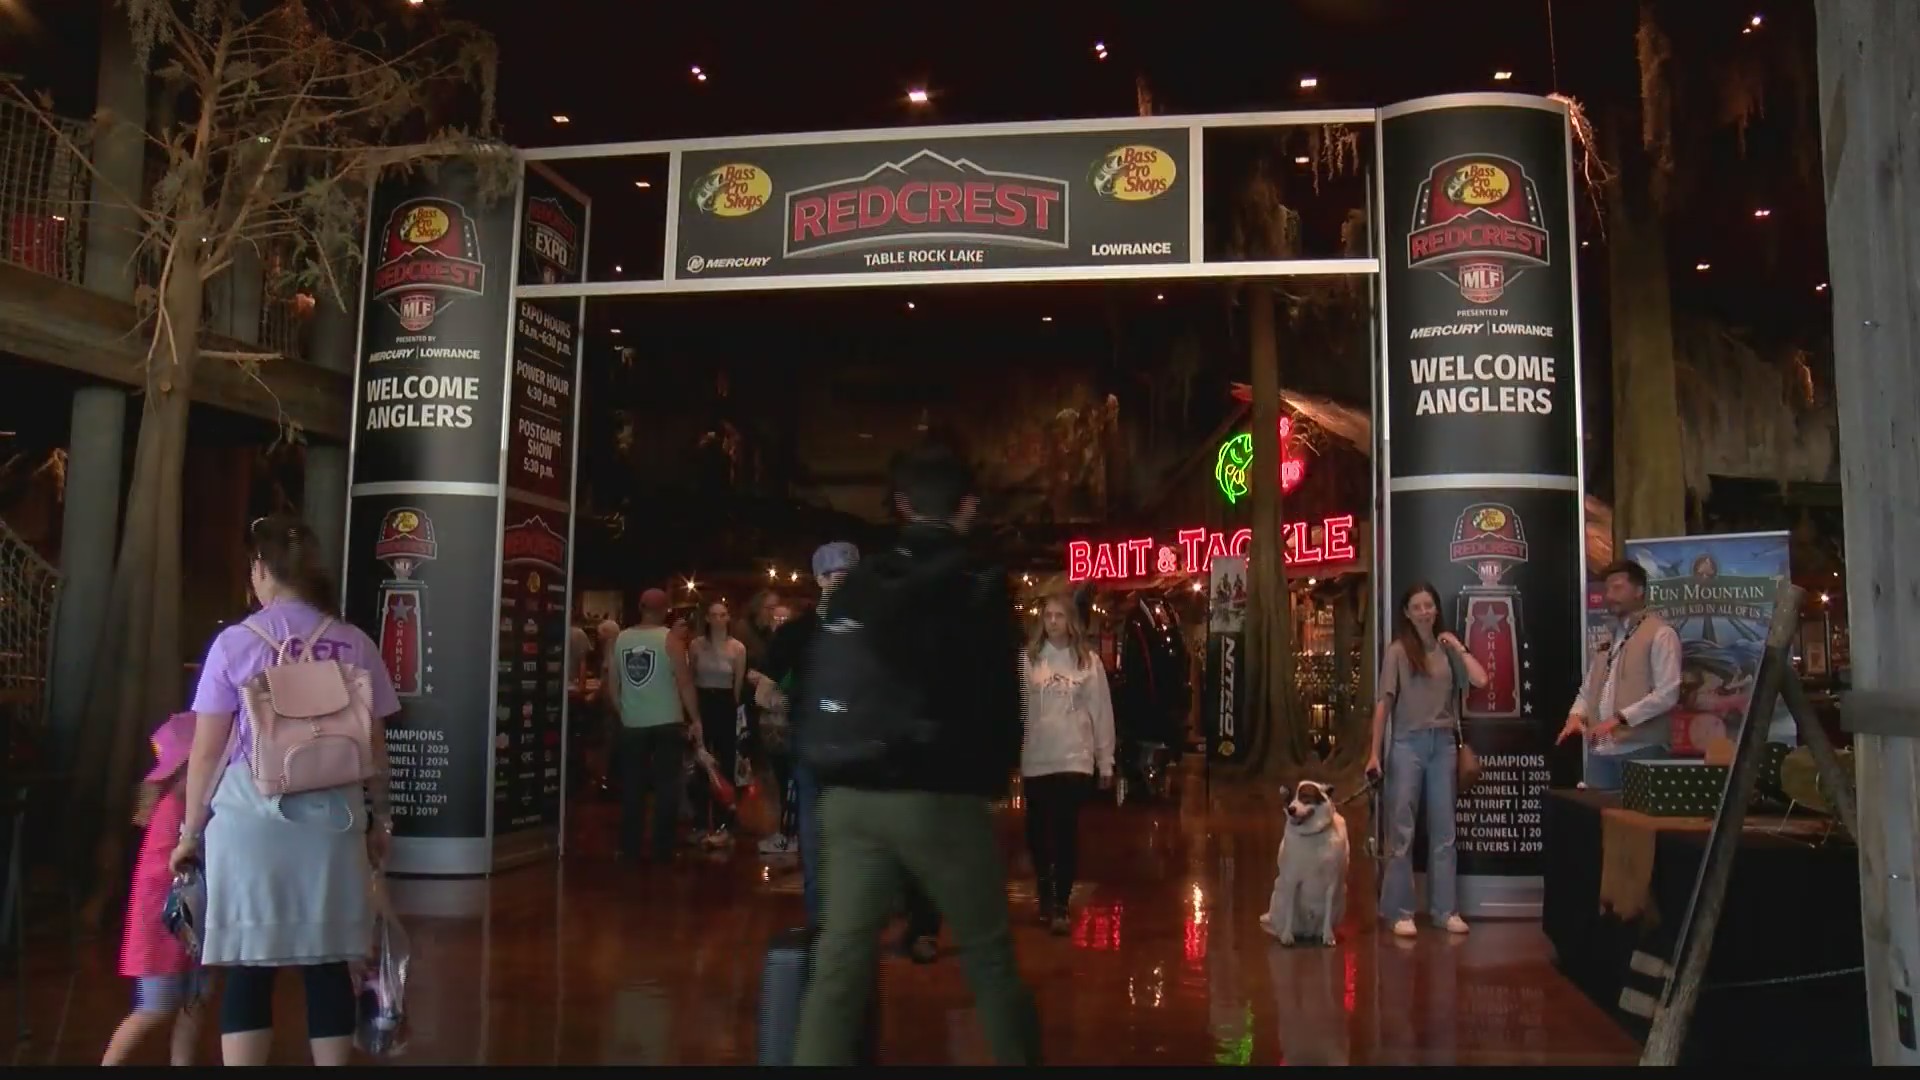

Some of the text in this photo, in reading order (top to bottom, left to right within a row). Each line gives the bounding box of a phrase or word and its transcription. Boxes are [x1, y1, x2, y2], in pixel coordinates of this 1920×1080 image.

[1124, 148, 1157, 163] Bass
[725, 166, 755, 180] Bass
[1125, 163, 1150, 178] Pro
[1470, 165, 1495, 177] Bass
[725, 181, 748, 195] Pro
[1124, 177, 1167, 194] Shops
[1472, 177, 1490, 188] Pro
[1472, 187, 1502, 200] Shops
[724, 193, 763, 210] Shops
[417, 208, 437, 218] Bass
[793, 181, 1059, 241] REDCREST
[536, 231, 567, 266] EXPO
[1091, 243, 1172, 256] LOWRANCE
[1412, 226, 1545, 258] REDCREST
[706, 257, 771, 268] MERCURY
[864, 249, 985, 266] TABLE ROCK LAKE
[376, 261, 480, 289] REDCREST
[1463, 270, 1500, 289] MLF
[403, 301, 431, 318] MLF
[1456, 308, 1509, 317] PRESENTED BY
[521, 301, 571, 339] EXPO HOURS
[1410, 323, 1553, 340] MERCURY LOWRANCE
[369, 348, 480, 363] MERCURY LOWRANCE
[1410, 353, 1556, 385] WELCOME
[516, 359, 569, 396] POWER HOUR
[366, 375, 479, 403] WELCOME
[1416, 386, 1553, 416] ANGLERS
[366, 404, 473, 430] ANGLERS
[518, 418, 562, 448] POSTGAME
[527, 438, 553, 461] SHOW
[1069, 537, 1152, 581] BAIT
[1157, 546, 1177, 573] &
[1649, 584, 1764, 600] FUN MOUNTAIN
[1688, 604, 1704, 614] KID
[1705, 604, 1715, 614] IN
[1719, 604, 1732, 614] ALL
[1735, 606, 1746, 617] OF
[1749, 608, 1760, 618] US
[1487, 631, 1496, 711] CHAMPION
[386, 729, 444, 741] HAMPIONS
[427, 744, 449, 753] 2025
[389, 756, 417, 766] NNELL
[426, 756, 449, 766] 2024
[1477, 755, 1545, 768] HAMPIONS
[391, 768, 410, 777] RIFT
[419, 769, 441, 778] 2023
[1528, 771, 1551, 781] 2025
[389, 780, 407, 790] ANE
[415, 781, 437, 791] 2022
[388, 793, 417, 803] NNELL
[425, 794, 448, 803] 2021
[1474, 799, 1511, 809] THRIFT
[1521, 799, 1542, 809] 202
[416, 807, 438, 816] 2019
[1456, 812, 1476, 822] BBY
[1480, 813, 1507, 823] LANE
[1517, 813, 1541, 823] 2022
[1471, 827, 1519, 837] CONNELL
[1476, 841, 1509, 851] EVERS
[1520, 841, 1542, 852] 2019
